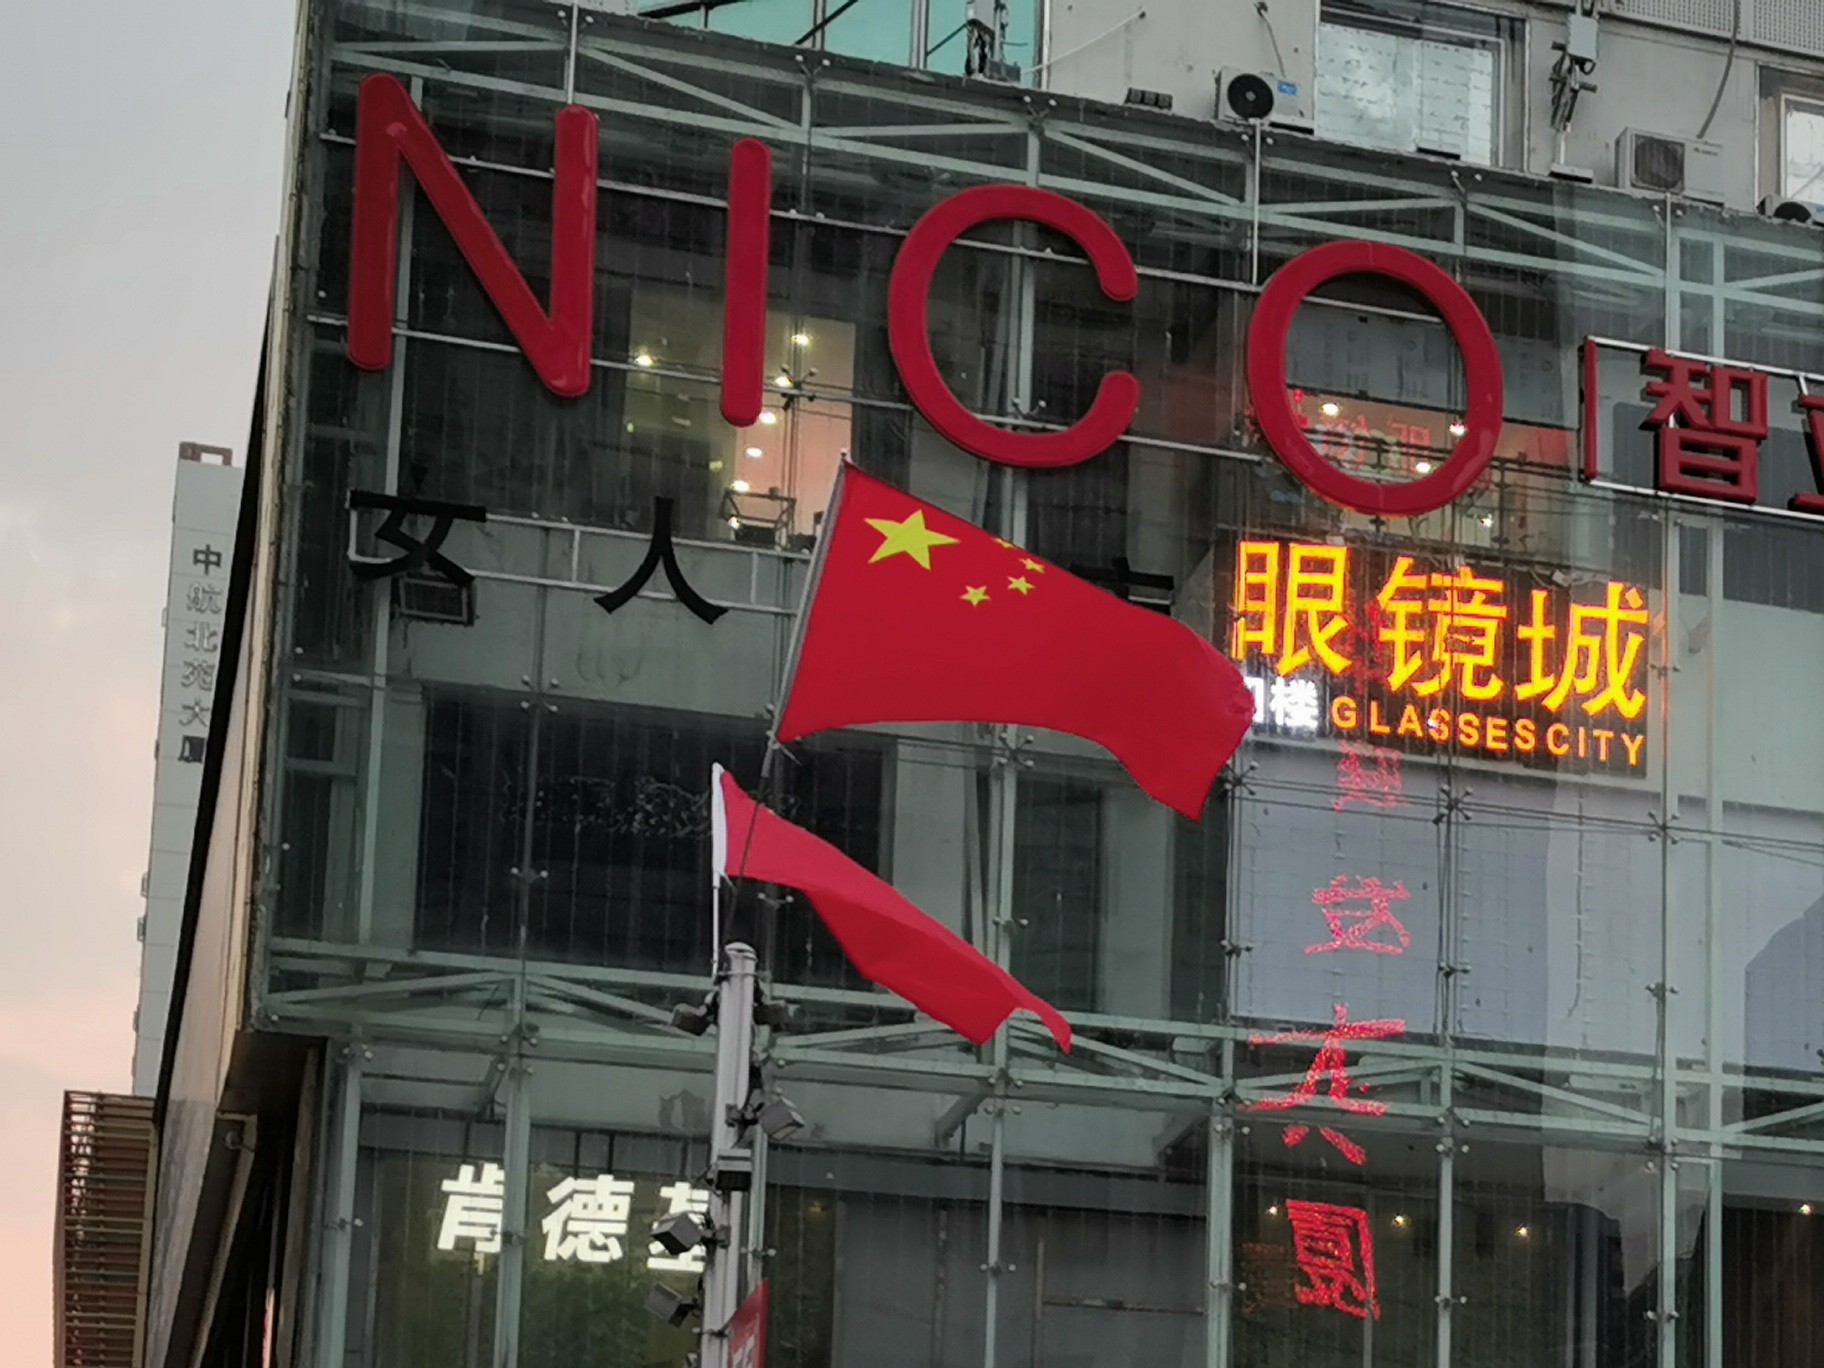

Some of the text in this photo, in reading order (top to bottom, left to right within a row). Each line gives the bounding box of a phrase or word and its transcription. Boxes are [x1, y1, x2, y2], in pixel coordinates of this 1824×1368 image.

[346, 70, 1500, 516] NICO
[1231, 540, 1649, 719] 眼镜城
[1246, 672, 1318, 729] 楼
[1331, 695, 1645, 767] GLASSES CITY
